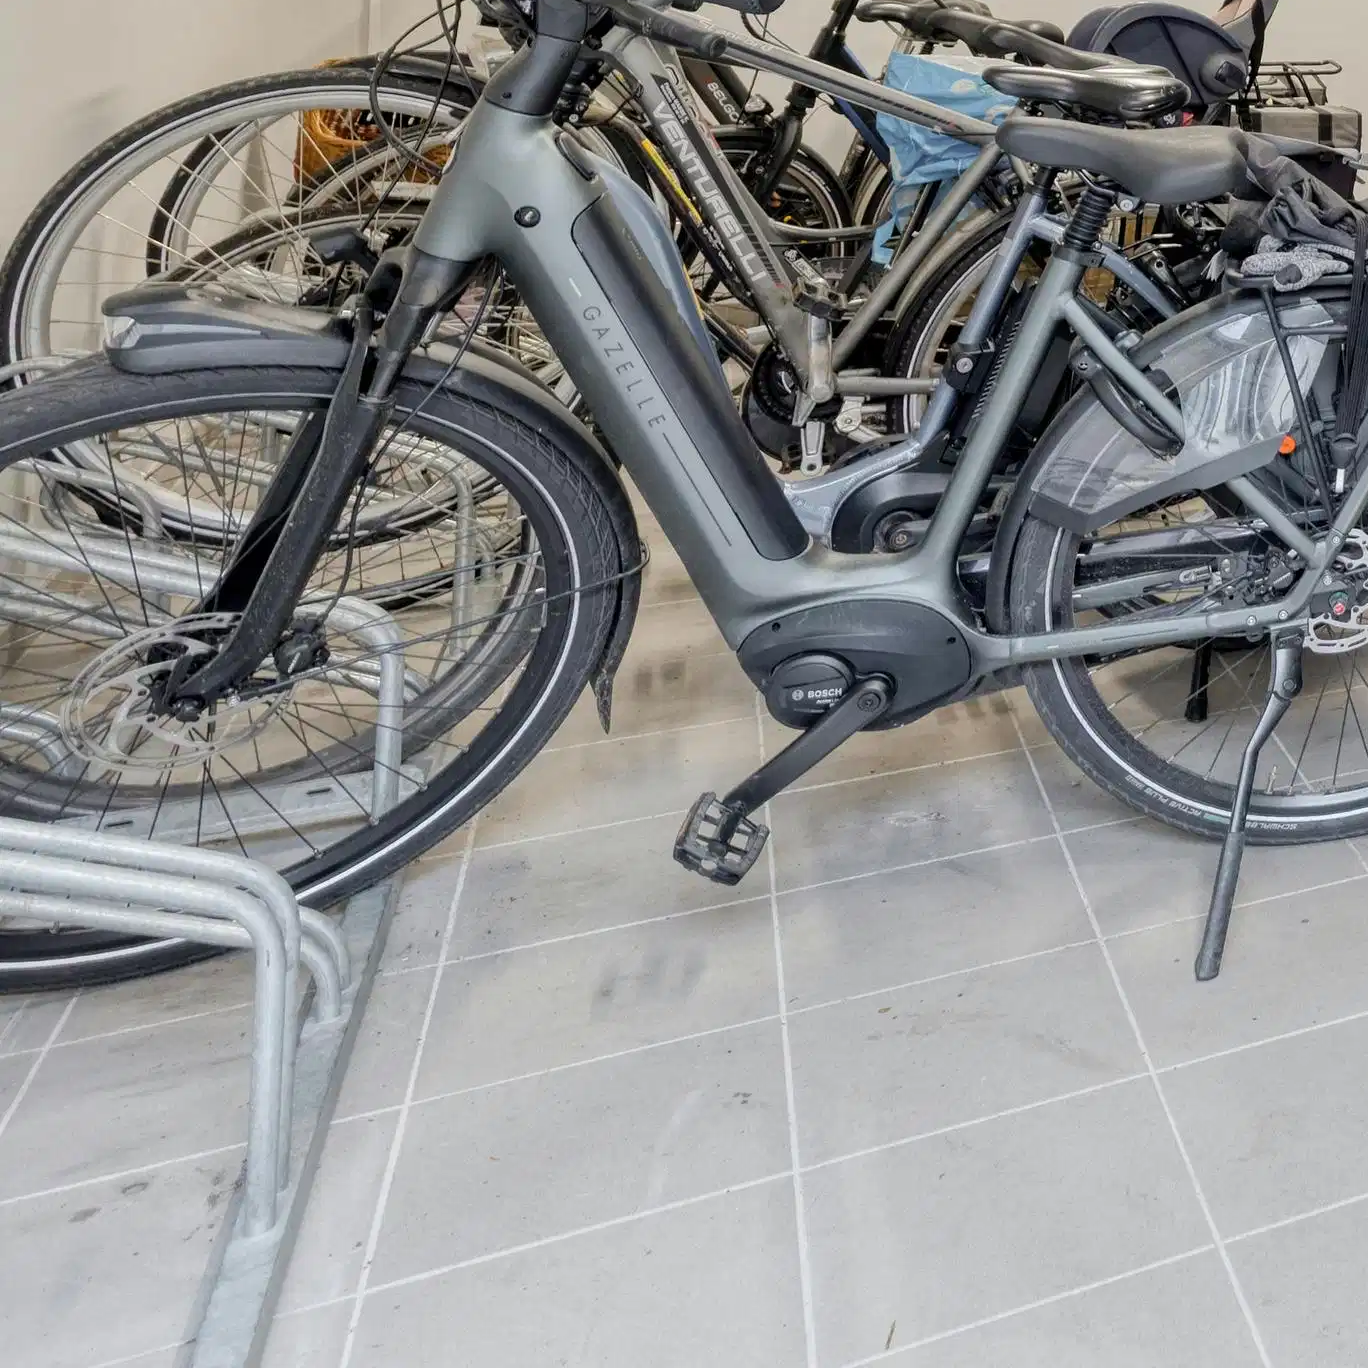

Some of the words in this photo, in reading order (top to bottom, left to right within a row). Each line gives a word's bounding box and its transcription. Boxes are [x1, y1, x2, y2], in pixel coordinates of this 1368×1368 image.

[653, 100, 767, 283] VENTURELLI
[583, 306, 666, 429] GAZELLE
[807, 688, 842, 699] BOSCH
